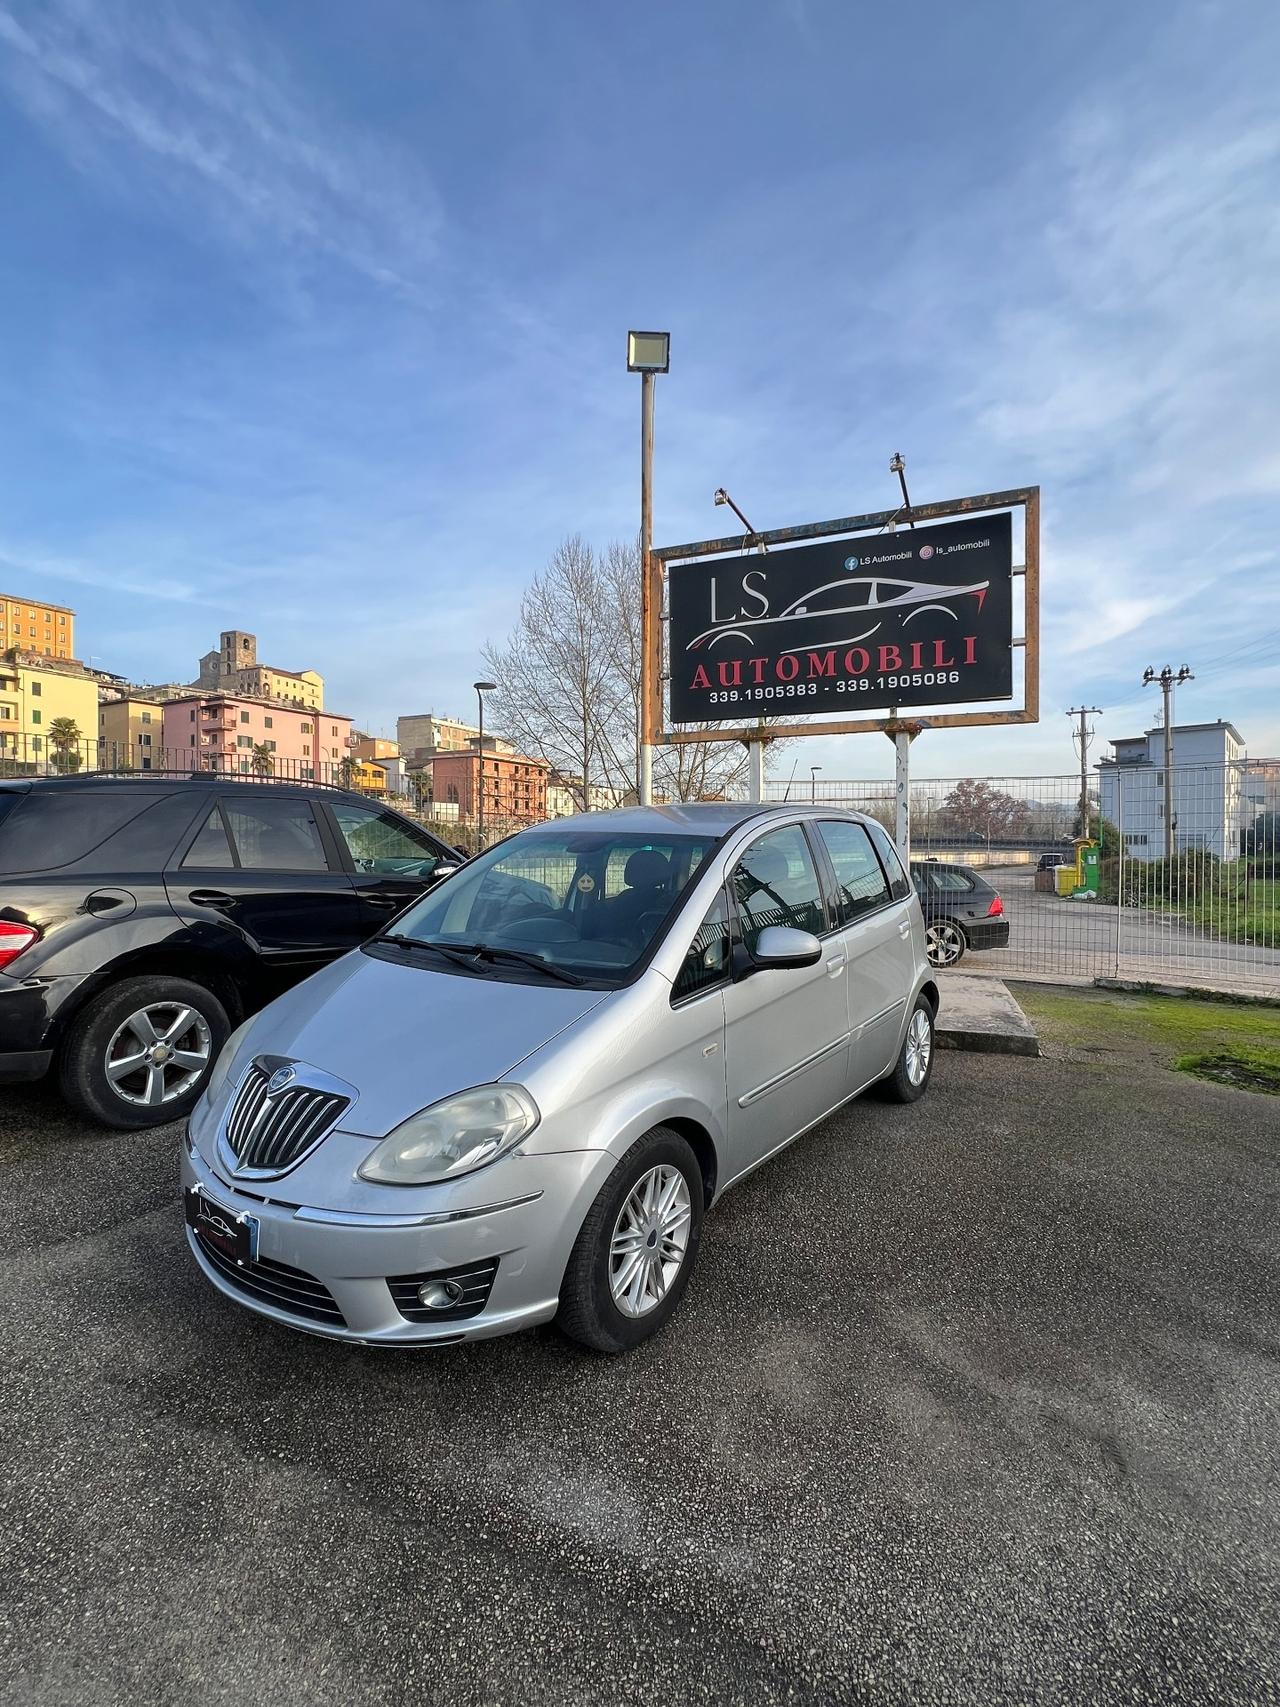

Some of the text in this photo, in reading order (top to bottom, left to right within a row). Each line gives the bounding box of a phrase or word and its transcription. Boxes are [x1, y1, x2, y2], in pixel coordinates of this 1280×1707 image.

[860, 551, 913, 566] LS Automobili
[936, 539, 990, 555] ls_automobili
[711, 571, 769, 623] LS
[689, 635, 977, 690] AUTOMOBILI
[709, 683, 817, 703] 339.1905383
[836, 671, 960, 693] 339.1905086
